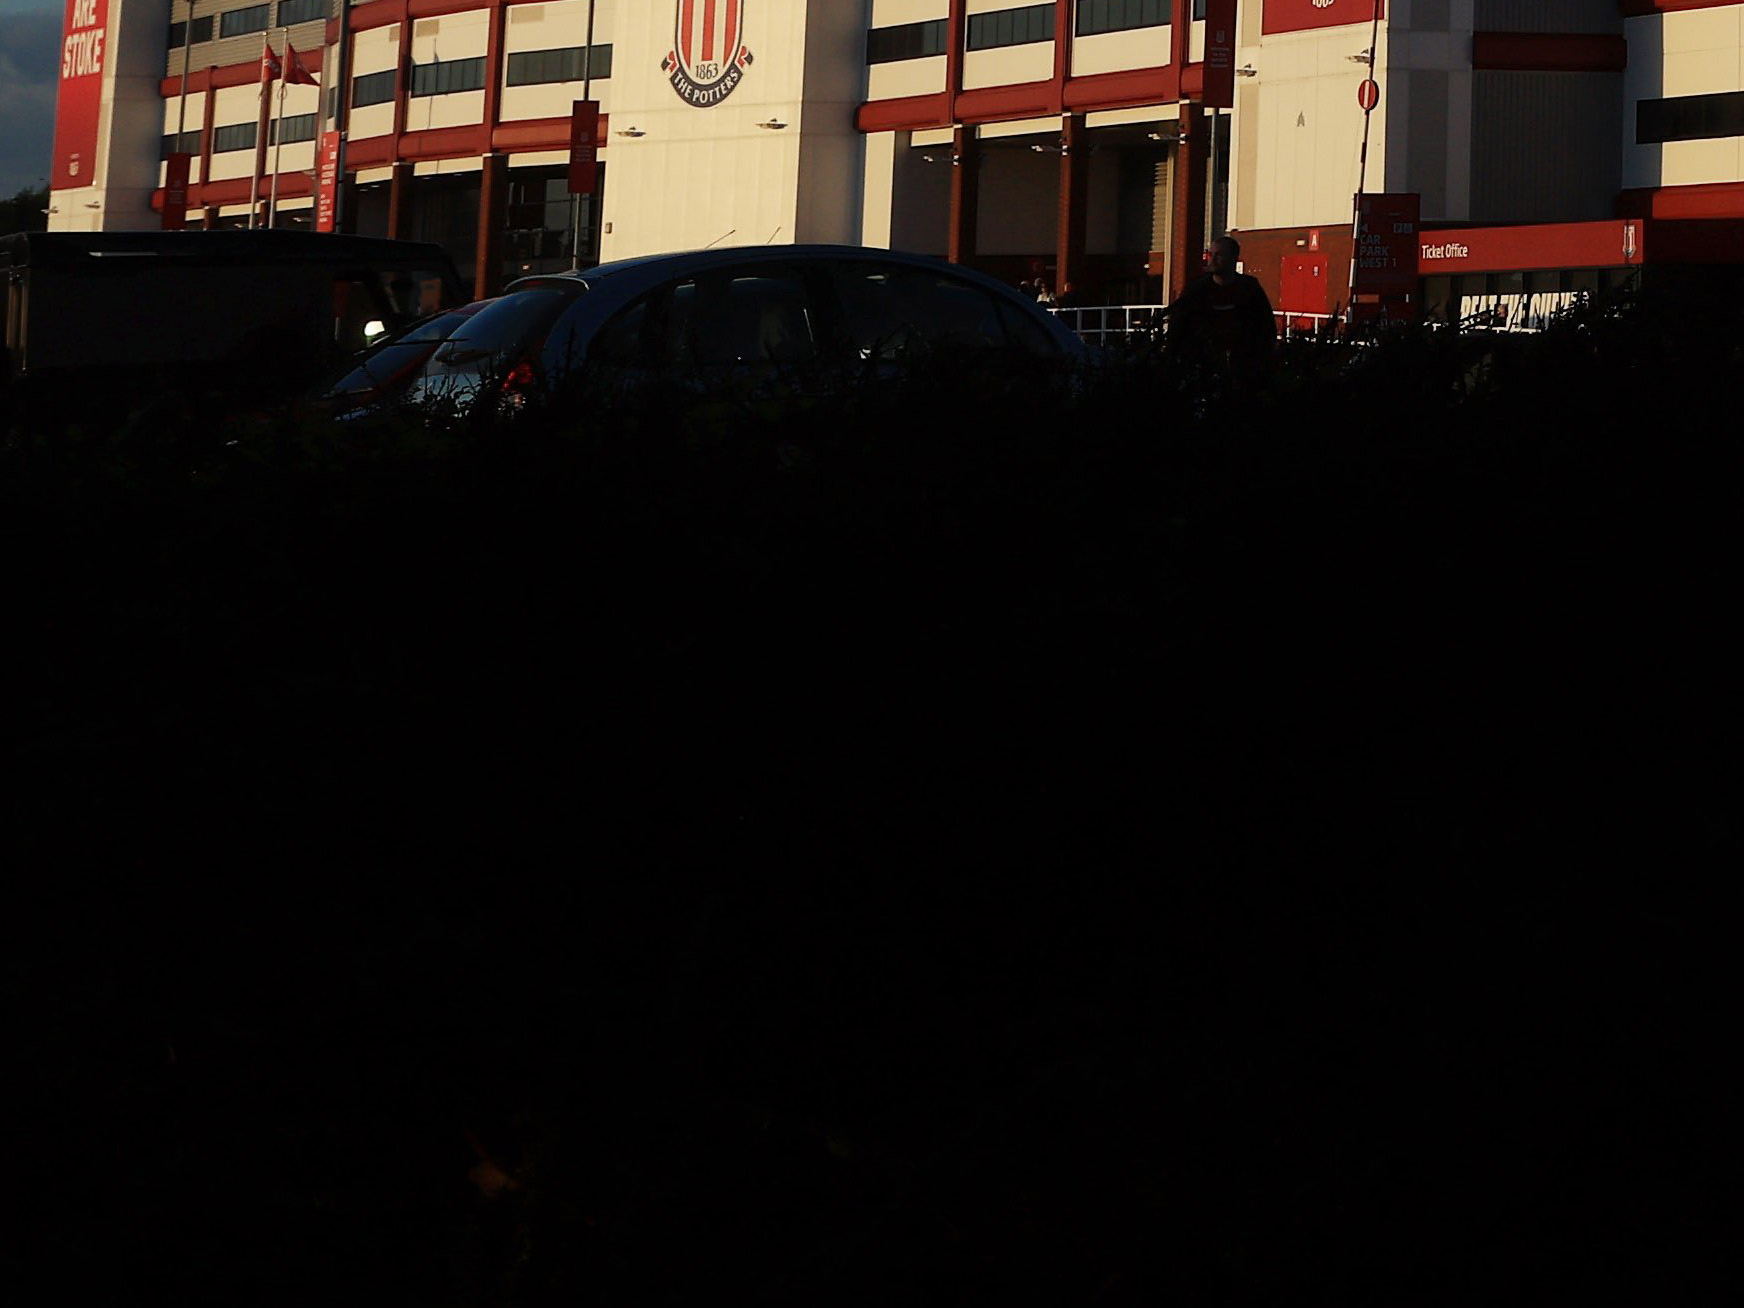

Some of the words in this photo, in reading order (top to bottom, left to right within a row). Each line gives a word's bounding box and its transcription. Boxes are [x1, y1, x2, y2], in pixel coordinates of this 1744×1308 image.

[62, 28, 104, 80] STOKE
[695, 63, 719, 80] 1863
[673, 72, 692, 98] THE
[692, 68, 740, 104] POTTERS
[1360, 234, 1380, 244] CAR
[1360, 246, 1390, 256] PARK
[1421, 244, 1445, 260] Ticket
[1445, 242, 1469, 258] Office
[1360, 257, 1388, 268] WEST
